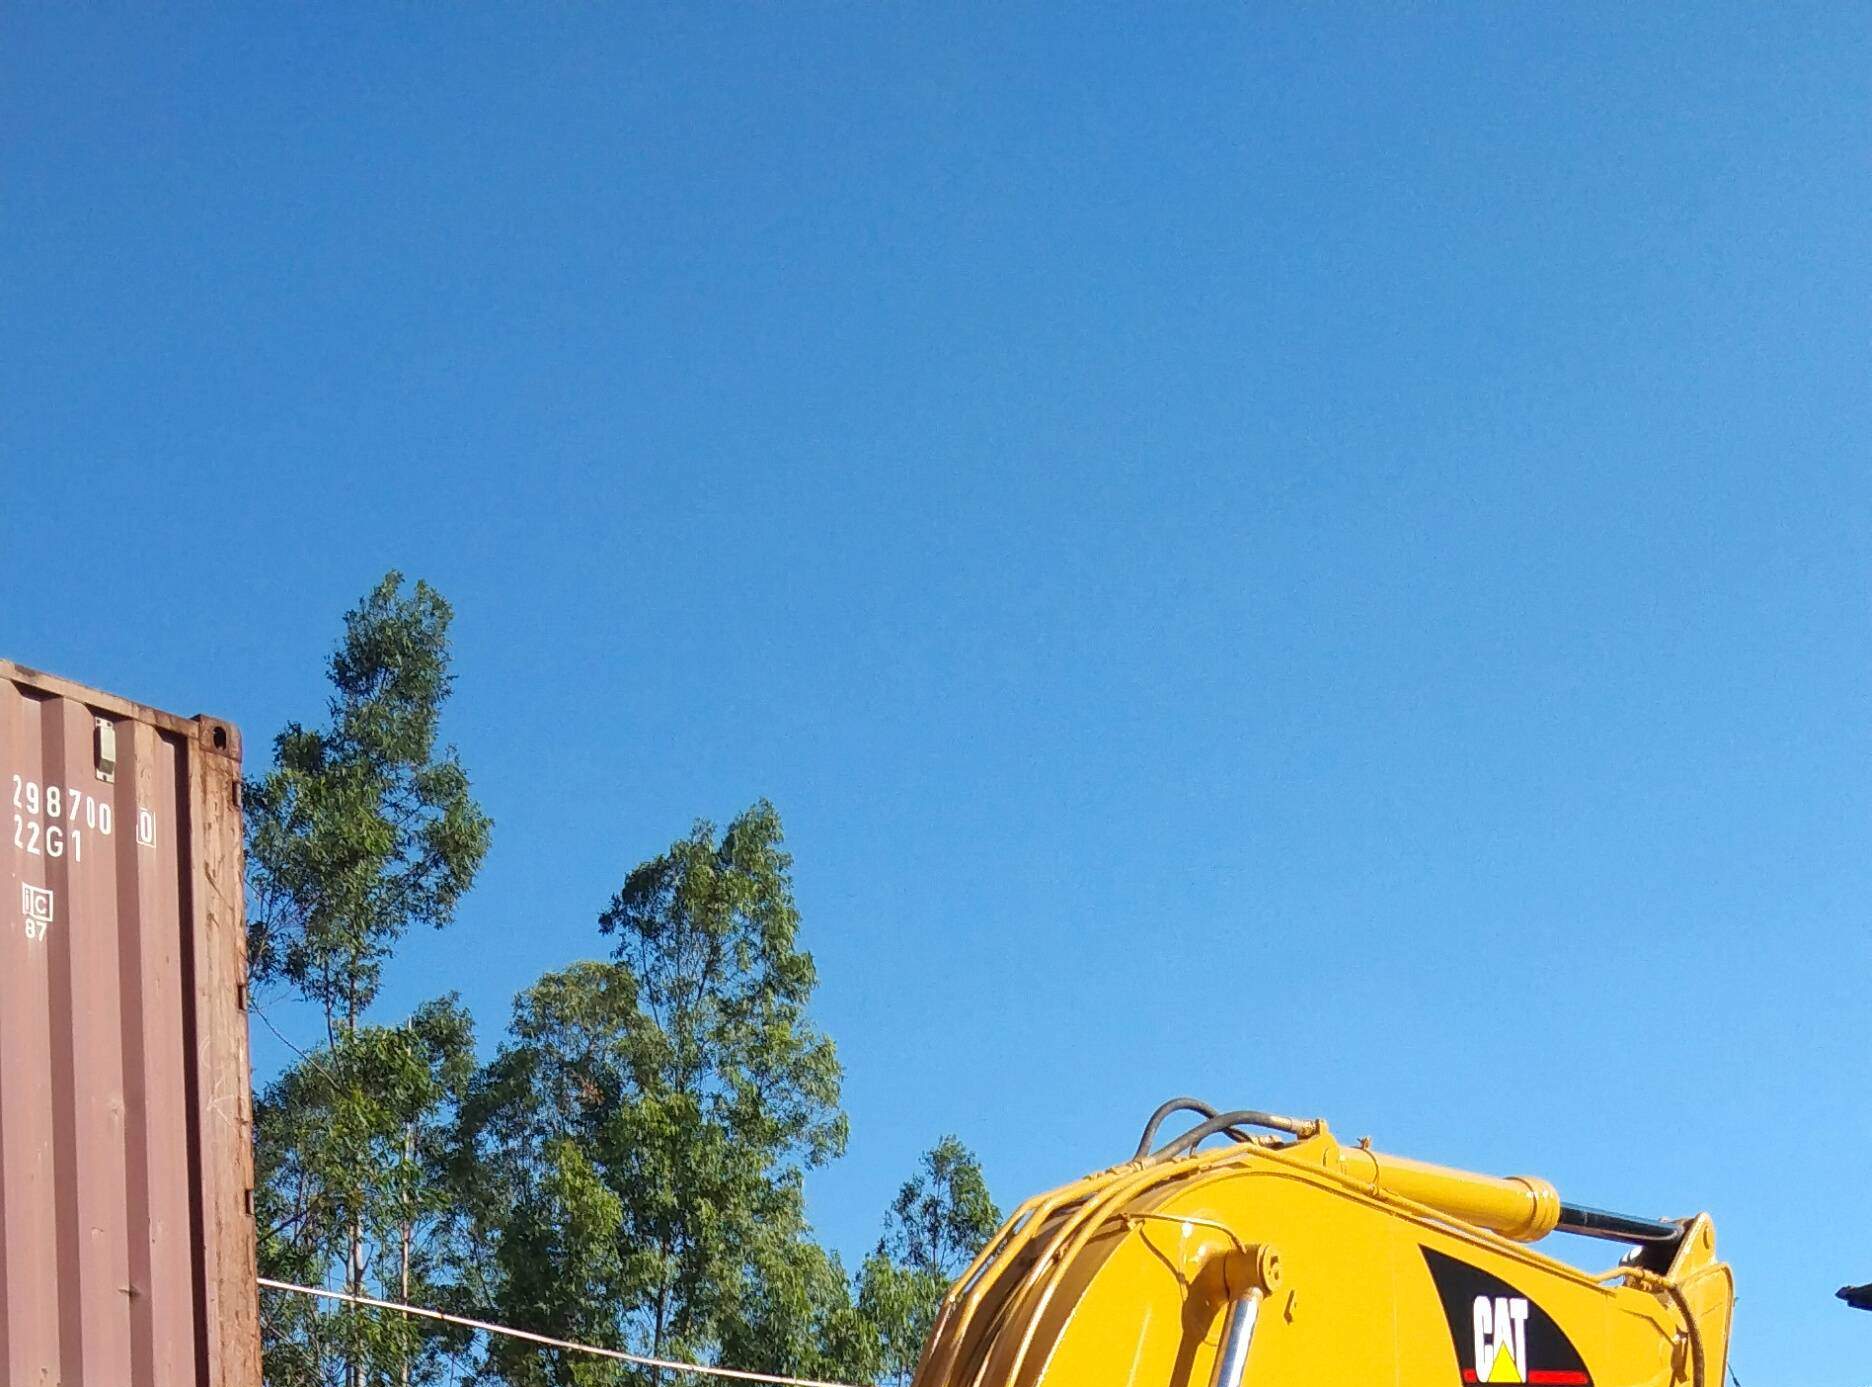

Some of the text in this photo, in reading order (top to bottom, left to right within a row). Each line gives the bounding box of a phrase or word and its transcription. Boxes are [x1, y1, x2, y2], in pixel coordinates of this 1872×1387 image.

[14, 814, 81, 862] 22G1
[25, 918, 47, 942] 87
[1473, 1296, 1528, 1383] CAT
